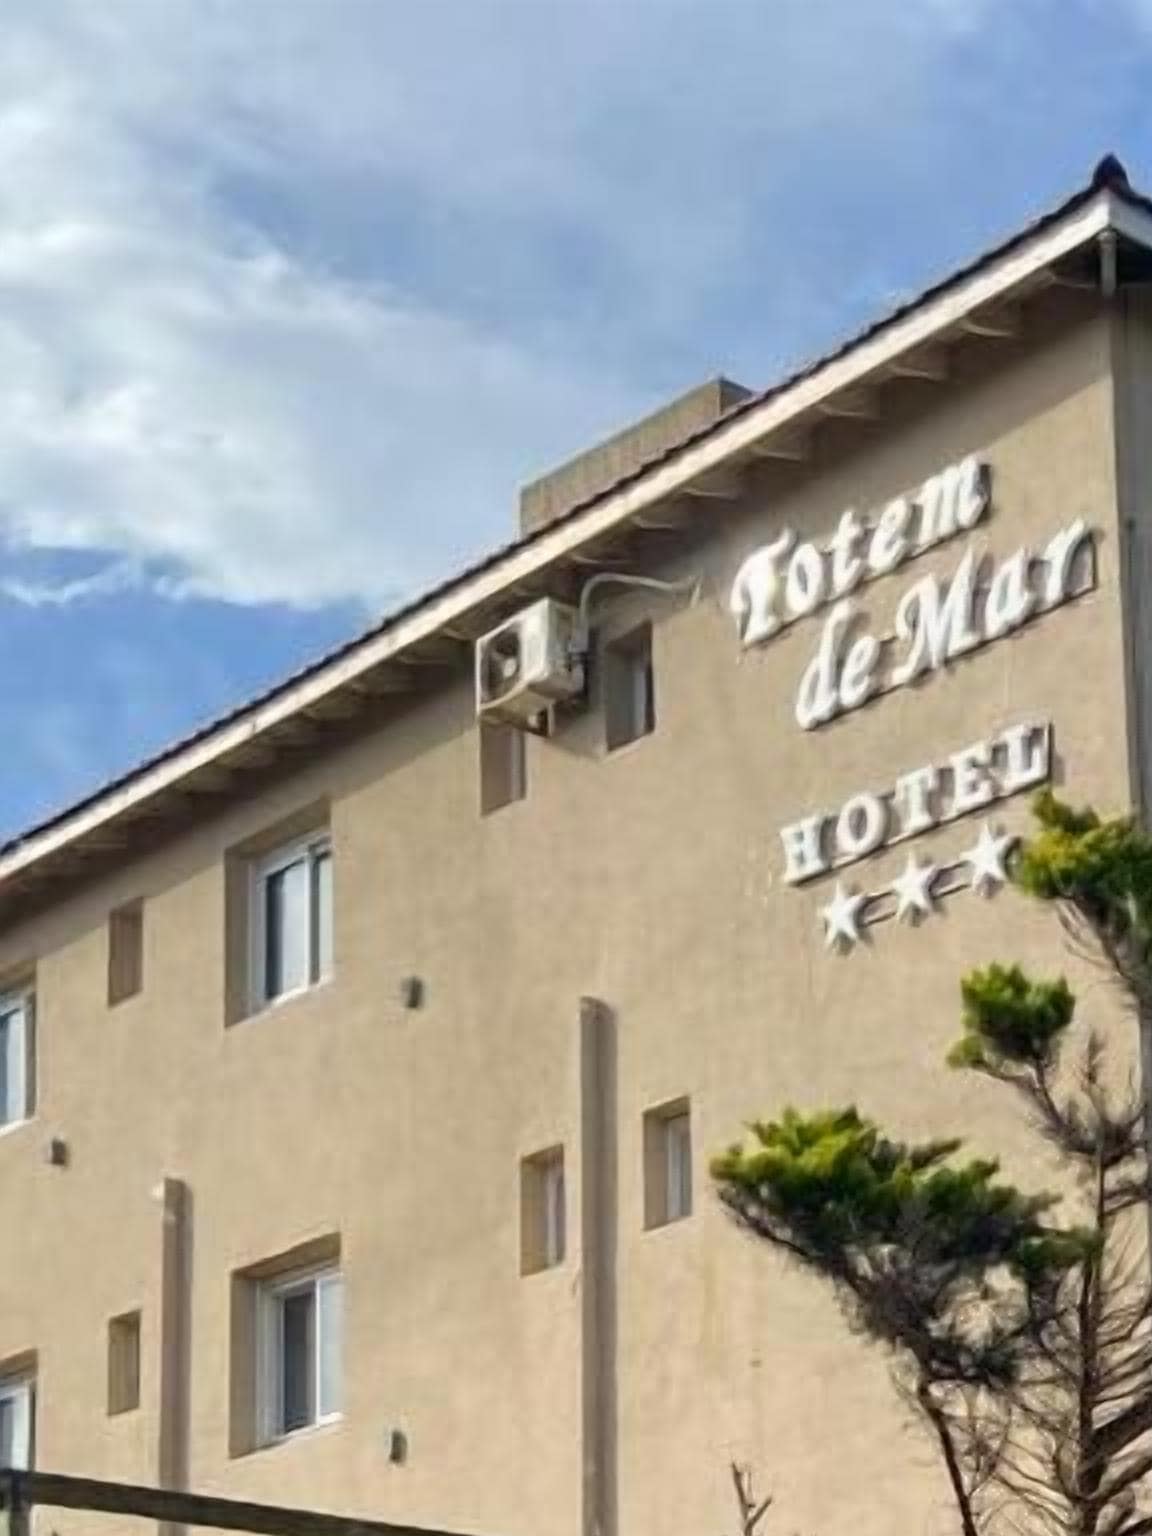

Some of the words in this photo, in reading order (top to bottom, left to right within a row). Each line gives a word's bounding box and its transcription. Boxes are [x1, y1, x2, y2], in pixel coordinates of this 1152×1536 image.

[731, 454, 988, 646] Totem
[796, 599, 882, 731] de
[893, 517, 1094, 684] Mar
[779, 721, 1051, 884] HOTEL
